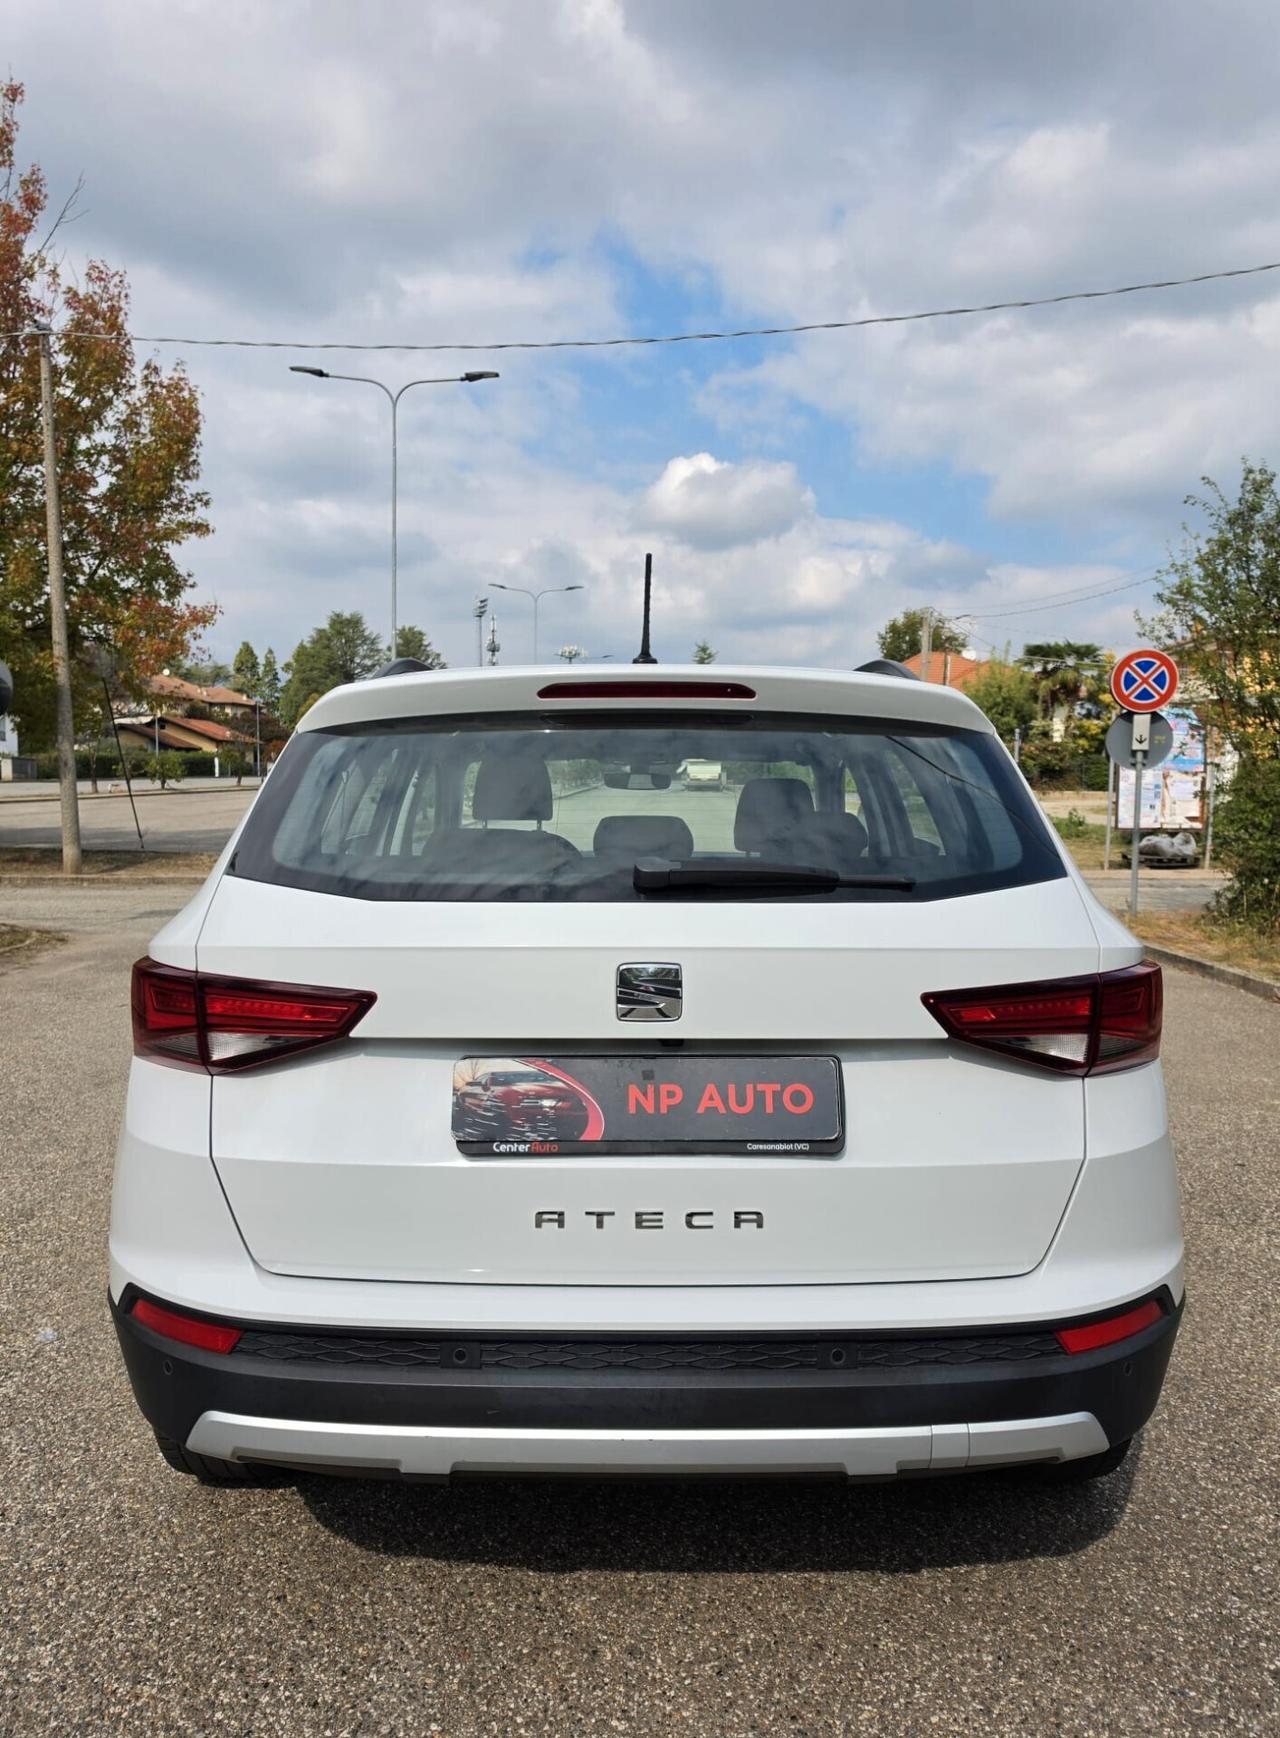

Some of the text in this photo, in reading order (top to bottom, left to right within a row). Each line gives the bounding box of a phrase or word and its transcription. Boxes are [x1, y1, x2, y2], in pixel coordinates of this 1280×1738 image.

[628, 1083, 815, 1114] NP AUTO
[794, 1142, 810, 1152] (VC)
[534, 1210, 764, 1229] ATECA
